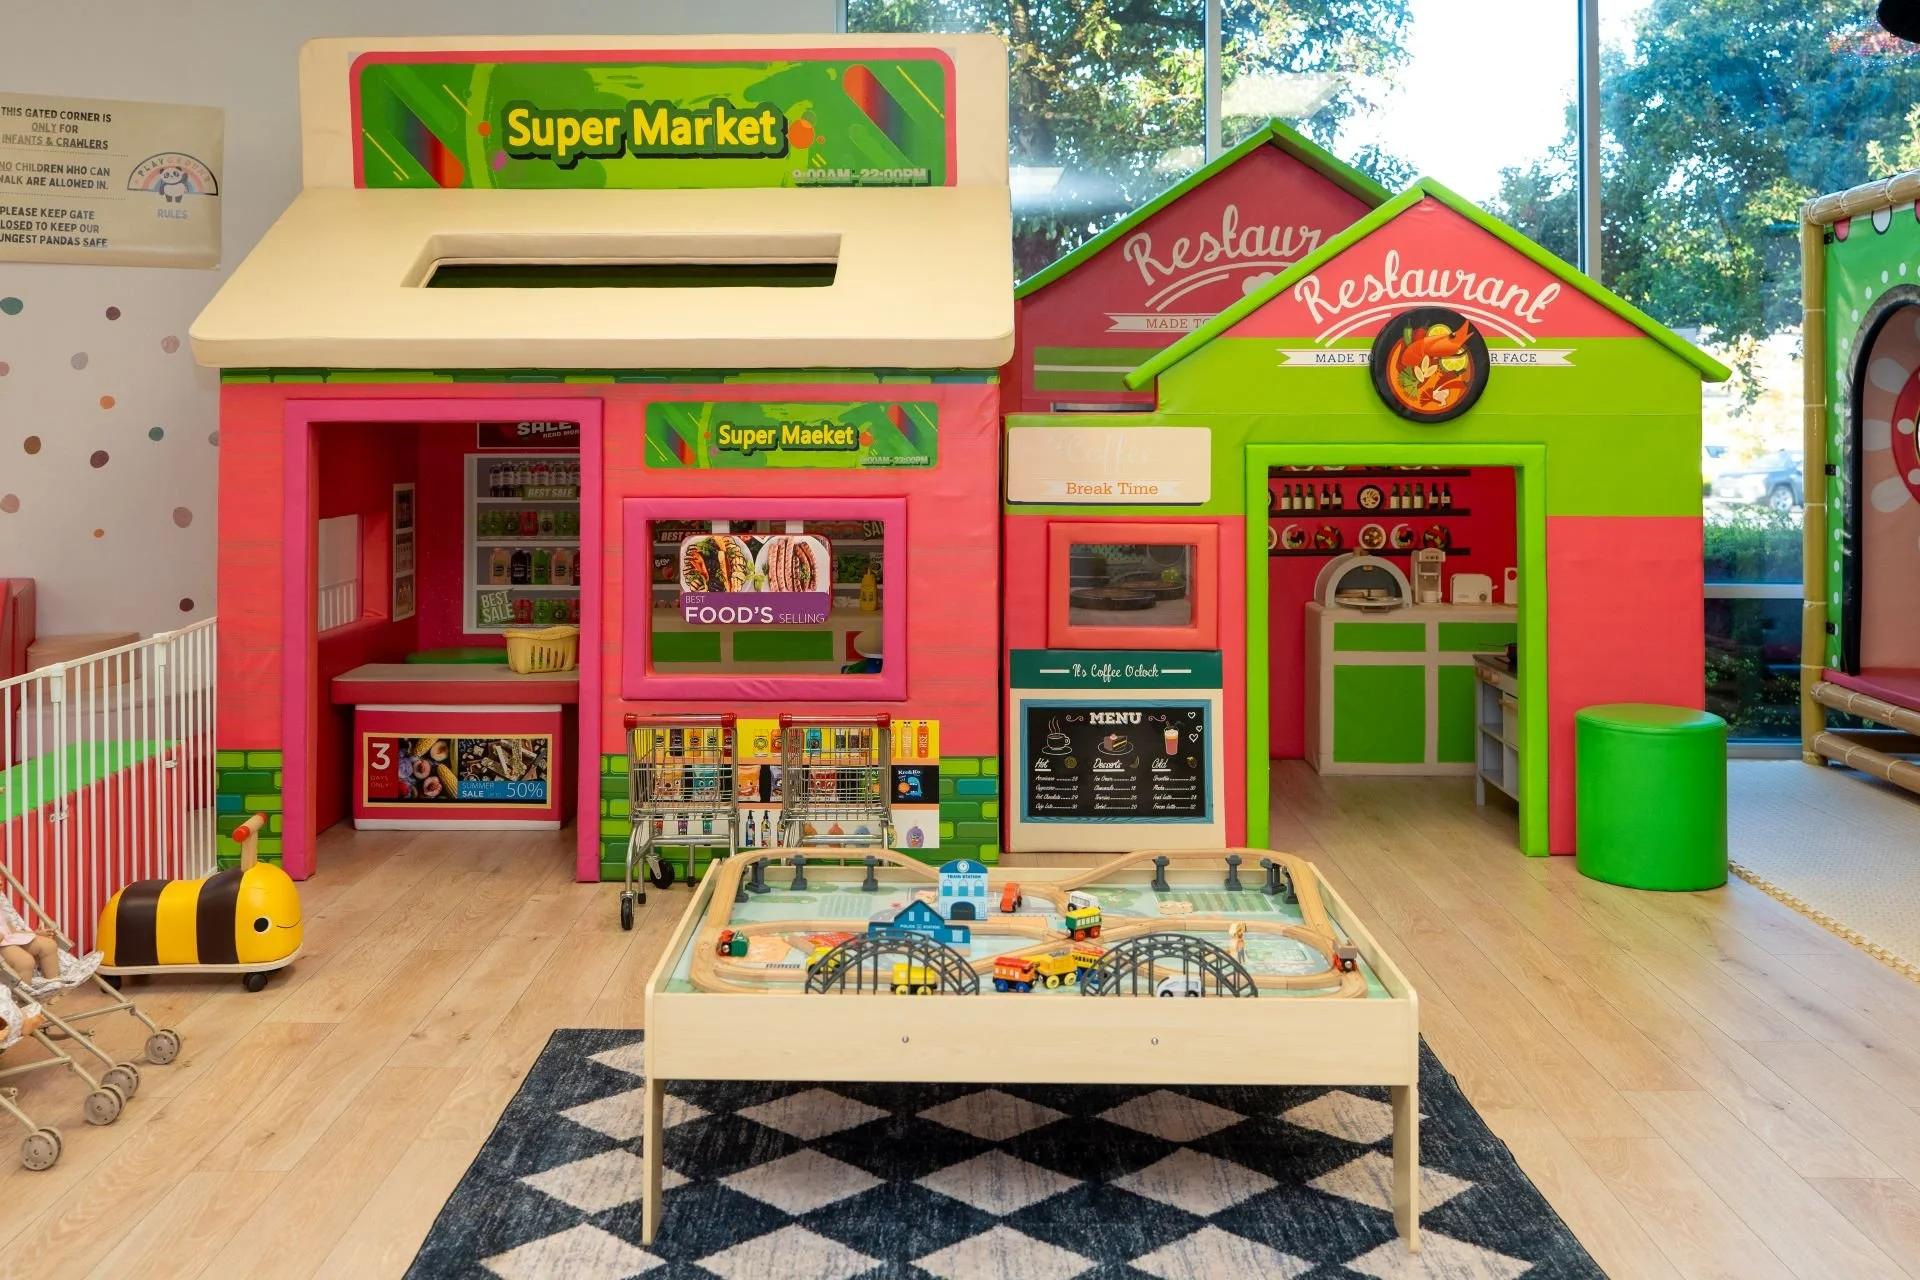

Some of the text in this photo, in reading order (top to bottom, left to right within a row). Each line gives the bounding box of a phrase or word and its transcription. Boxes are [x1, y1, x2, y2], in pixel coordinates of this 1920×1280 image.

[1, 106, 112, 123] THIS GATED CORNER IS
[31, 122, 79, 134] ONLY FOR
[508, 106, 777, 156] Super Market
[1, 133, 109, 150] INFANTS & CRAWLERS
[15, 162, 64, 174] CHILDREN
[66, 165, 88, 175] WHO
[89, 167, 111, 177] CAN
[26, 176, 46, 186] ARE
[49, 177, 94, 189] ALLOWED
[96, 180, 109, 190] IN.
[0, 205, 95, 220] PLEASE KEEP GATE
[157, 208, 188, 219] RULES
[0, 219, 100, 234] LOSED TO KEEP OUR
[0, 233, 108, 248] UNGEST PANDAS SAFE
[1123, 204, 1339, 287] Restaur
[1293, 249, 1562, 325] Restaurant
[1146, 318, 1188, 329] MADE
[1315, 353, 1355, 363] MADE
[1503, 353, 1537, 363] FACE
[516, 421, 572, 436] SALE
[719, 424, 854, 450] Super Maeket
[1066, 433, 1158, 474] Coffee
[528, 488, 573, 498] BEST SALE
[1065, 481, 1159, 495] Break Time
[661, 531, 684, 541] BEST
[481, 590, 510, 609] BEST
[685, 595, 706, 604] BEST
[482, 603, 515, 624] SALE
[685, 606, 825, 624] FOOD'S SELLING
[1090, 663, 1122, 683] Coffee
[1089, 711, 1143, 725] MENU
[371, 742, 391, 770] 3
[1034, 757, 1050, 769] Hot
[1093, 757, 1122, 769] Desserts
[1151, 757, 1169, 769] Cold
[462, 782, 495, 790] SUMMER
[462, 790, 484, 798] SALE
[506, 782, 543, 798] 50%
